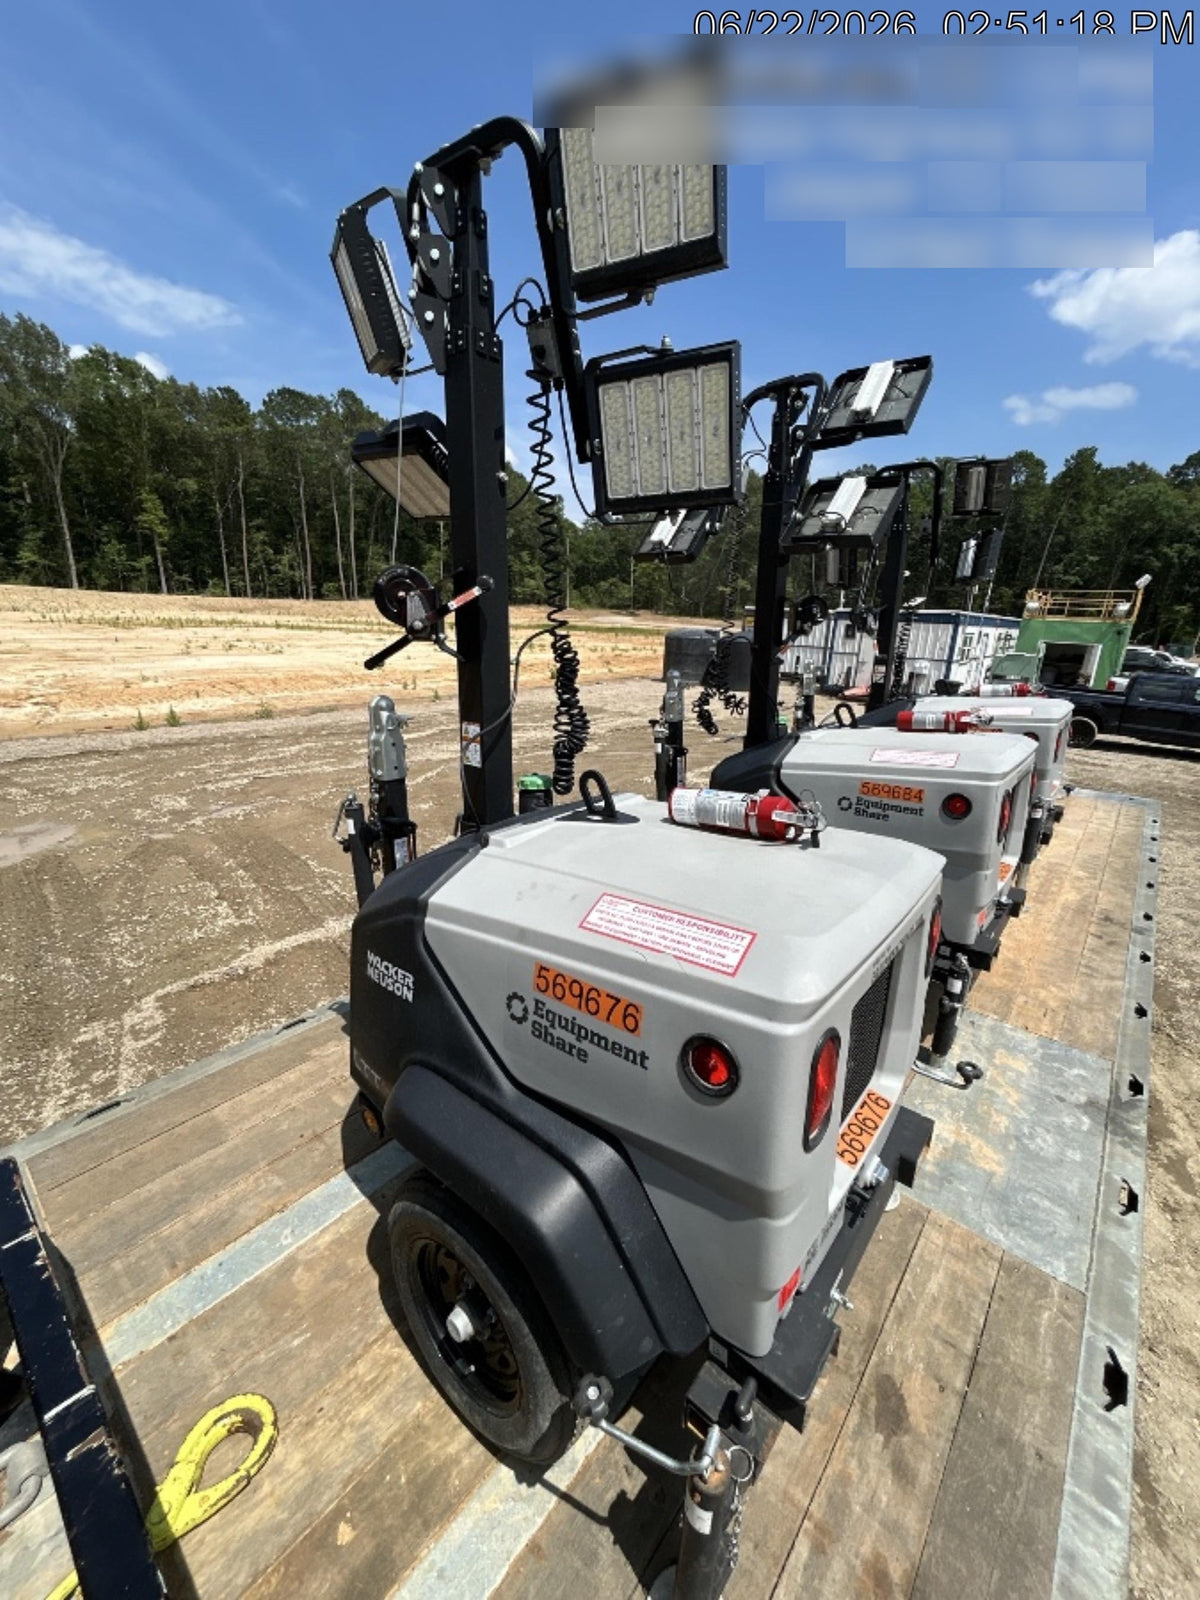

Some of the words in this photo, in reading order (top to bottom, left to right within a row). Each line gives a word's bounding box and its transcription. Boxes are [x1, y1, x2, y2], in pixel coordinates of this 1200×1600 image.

[855, 796, 924, 816] Equipment
[367, 950, 414, 989] WACKER
[367, 963, 414, 1003] NEUSON
[536, 965, 641, 1034] 569676
[530, 1023, 589, 1064] Share
[532, 998, 650, 1070] Equipment
[837, 1092, 891, 1165] 569676
